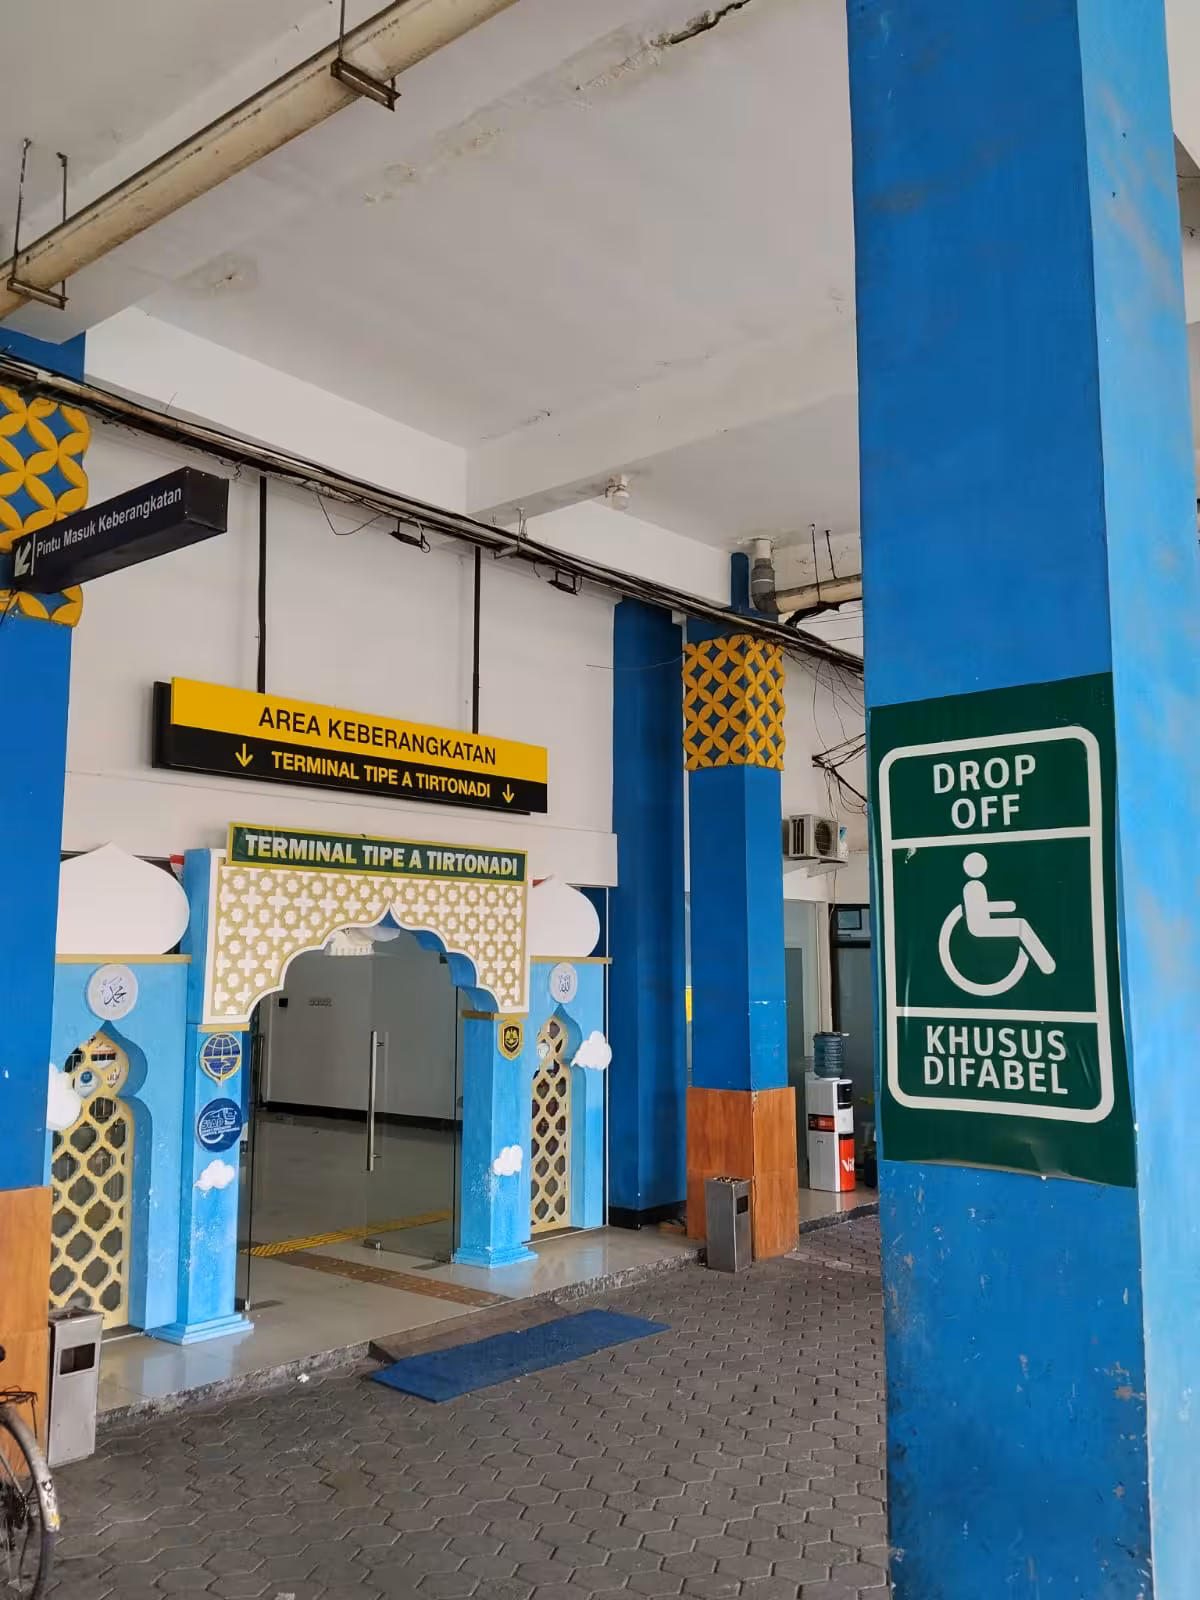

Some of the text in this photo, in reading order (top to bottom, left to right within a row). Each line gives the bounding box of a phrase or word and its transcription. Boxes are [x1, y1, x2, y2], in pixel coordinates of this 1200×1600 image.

[36, 488, 182, 558] Pintu Masuk Keberangkatan
[258, 706, 497, 766] AREA KEBERANGKATAN
[271, 750, 491, 799] TERMINAL TIPE A TIRTONADI
[933, 754, 1036, 794] DROP
[951, 794, 1021, 830] OFF
[244, 833, 518, 877] TERMINAL TIPE A TIRTONADI
[926, 1025, 1067, 1061] KHUSUS
[923, 1055, 1068, 1094] DIFABEL
